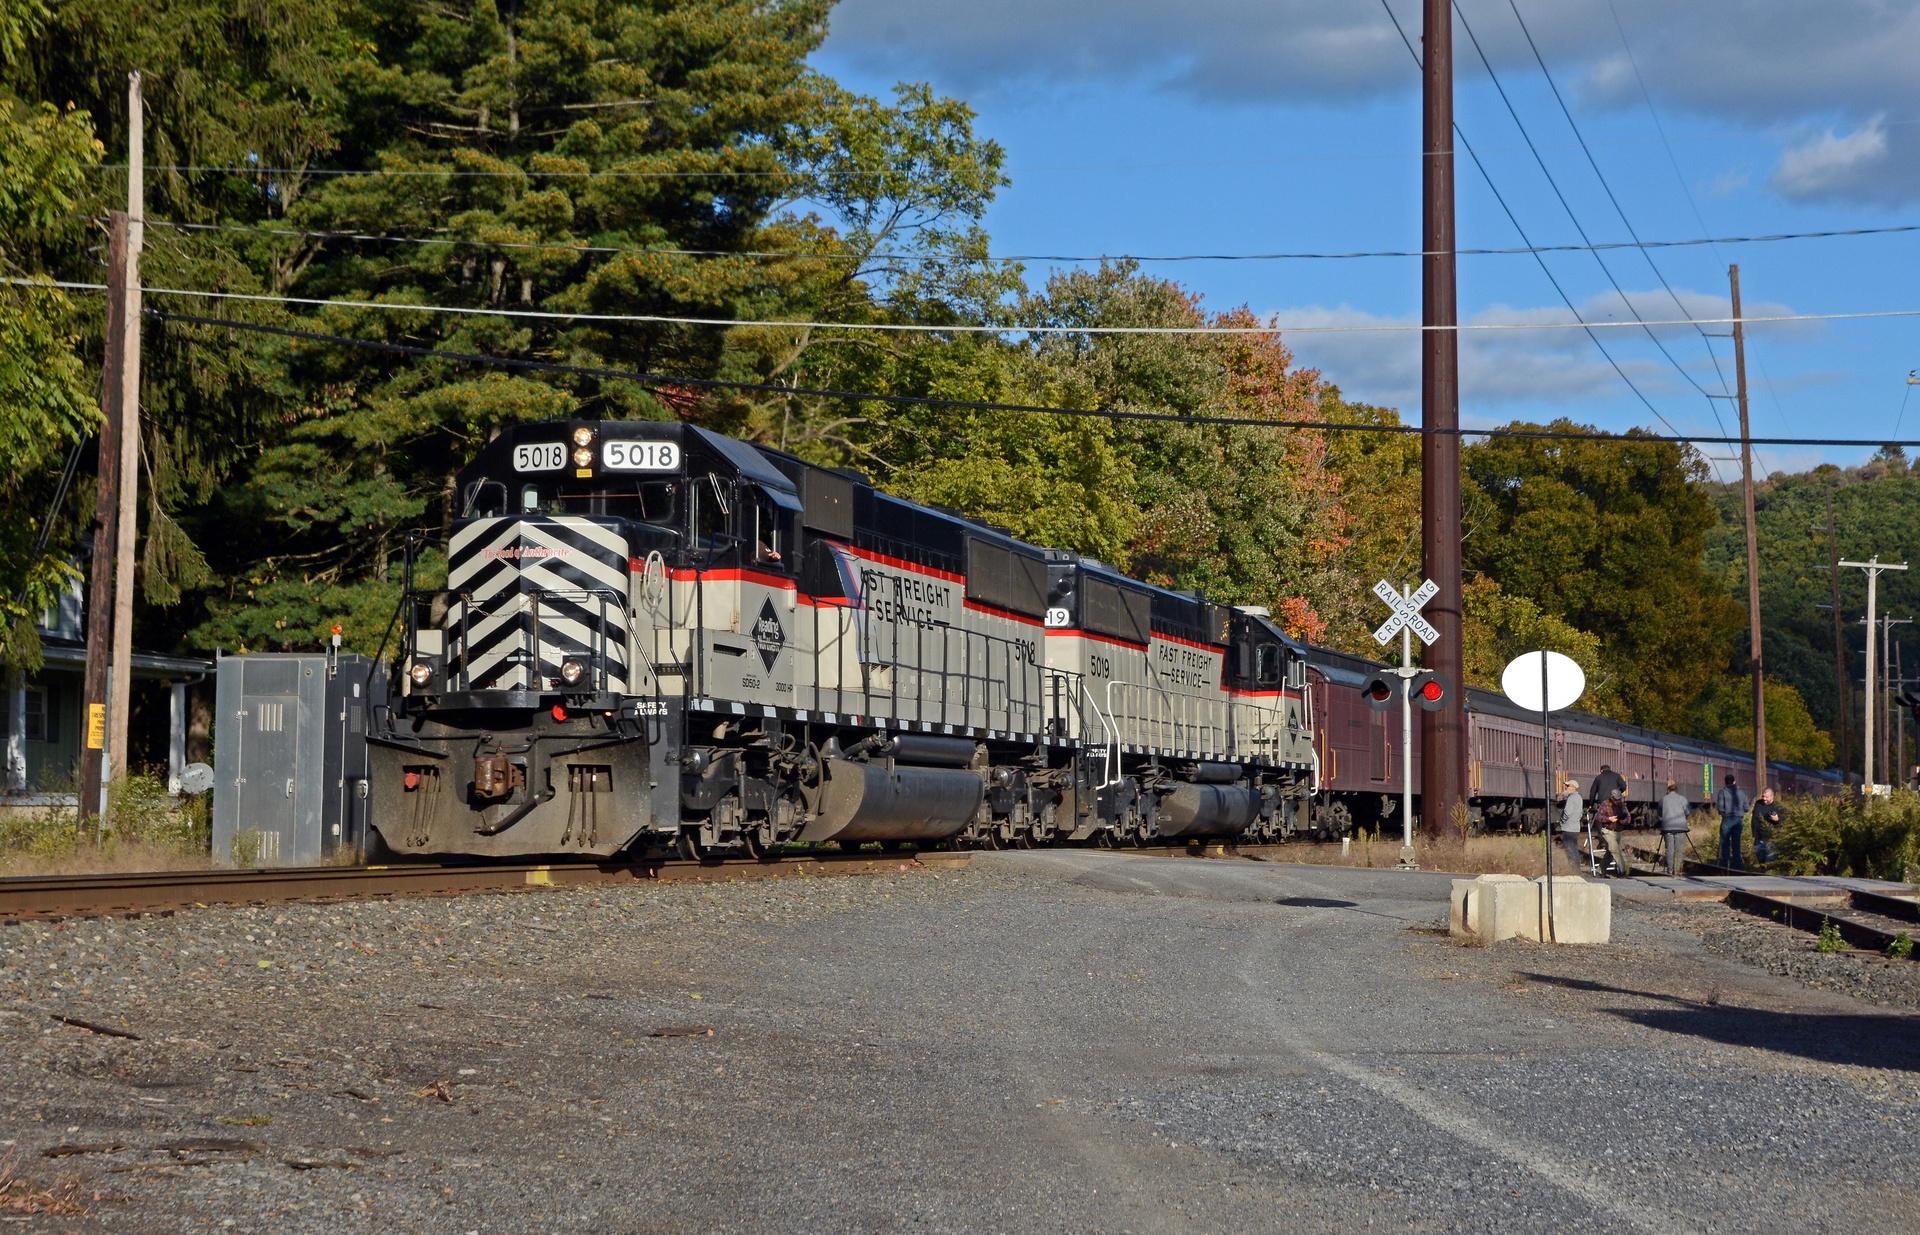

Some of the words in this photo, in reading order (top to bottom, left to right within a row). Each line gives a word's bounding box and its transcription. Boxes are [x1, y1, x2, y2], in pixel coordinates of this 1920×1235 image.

[519, 446, 562, 469] 5018
[611, 444, 673, 467] 5018
[1377, 582, 1435, 641] CROSSING
[1090, 654, 1110, 679] 5019
[1159, 644, 1178, 663] FAST
[1182, 650, 1212, 671] FREIGHT
